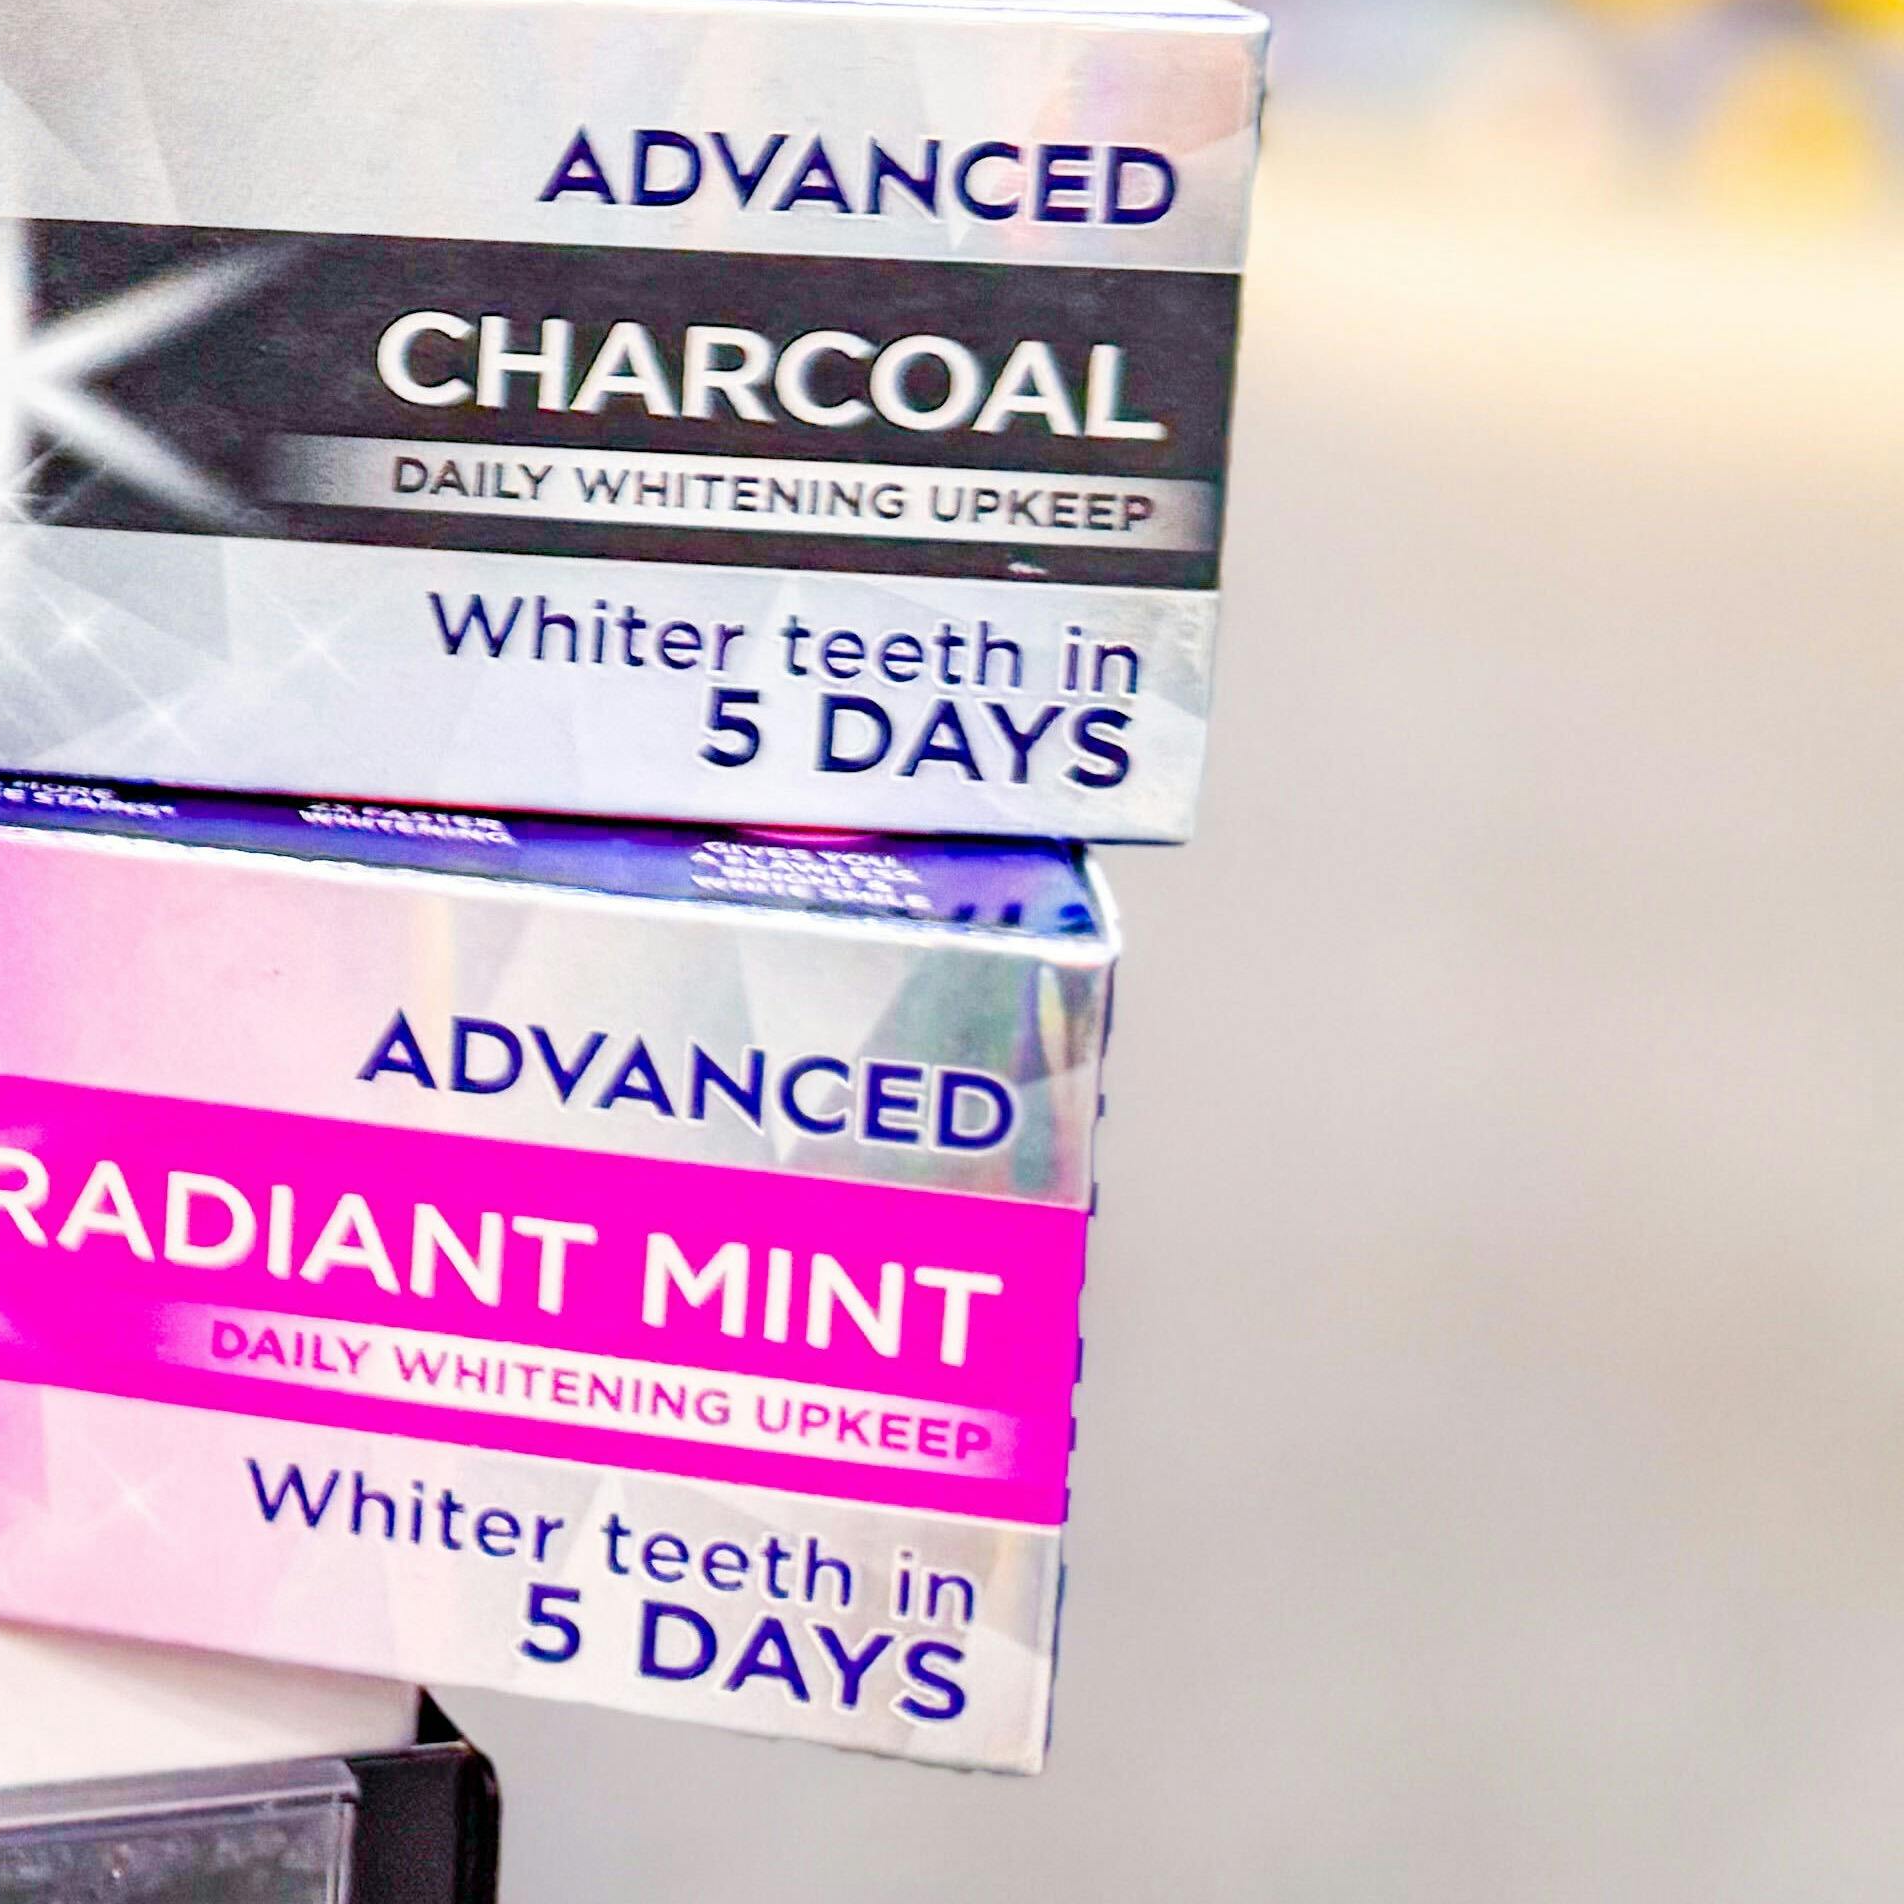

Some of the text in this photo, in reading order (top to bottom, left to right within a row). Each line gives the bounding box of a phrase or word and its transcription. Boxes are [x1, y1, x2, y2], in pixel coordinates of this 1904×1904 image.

[538, 126, 1180, 229] ADVANCED
[374, 307, 1168, 444] CHARCOAL
[391, 454, 1156, 534] DAILY WHITENING UPKEEP
[425, 589, 1142, 698] Whiter teeth in
[698, 688, 1134, 792] 5 DAYS
[701, 840, 898, 869] GIVES YOU
[719, 853, 921, 884] FLAWLESS
[354, 1005, 1018, 1155] ADVANCED
[639, 1231, 1004, 1372] MINT
[209, 1315, 995, 1466] DAILY WHITENING UPKEEP
[243, 1456, 981, 1625] Whiter teeth in
[520, 1585, 970, 1726] 5 DAYS
